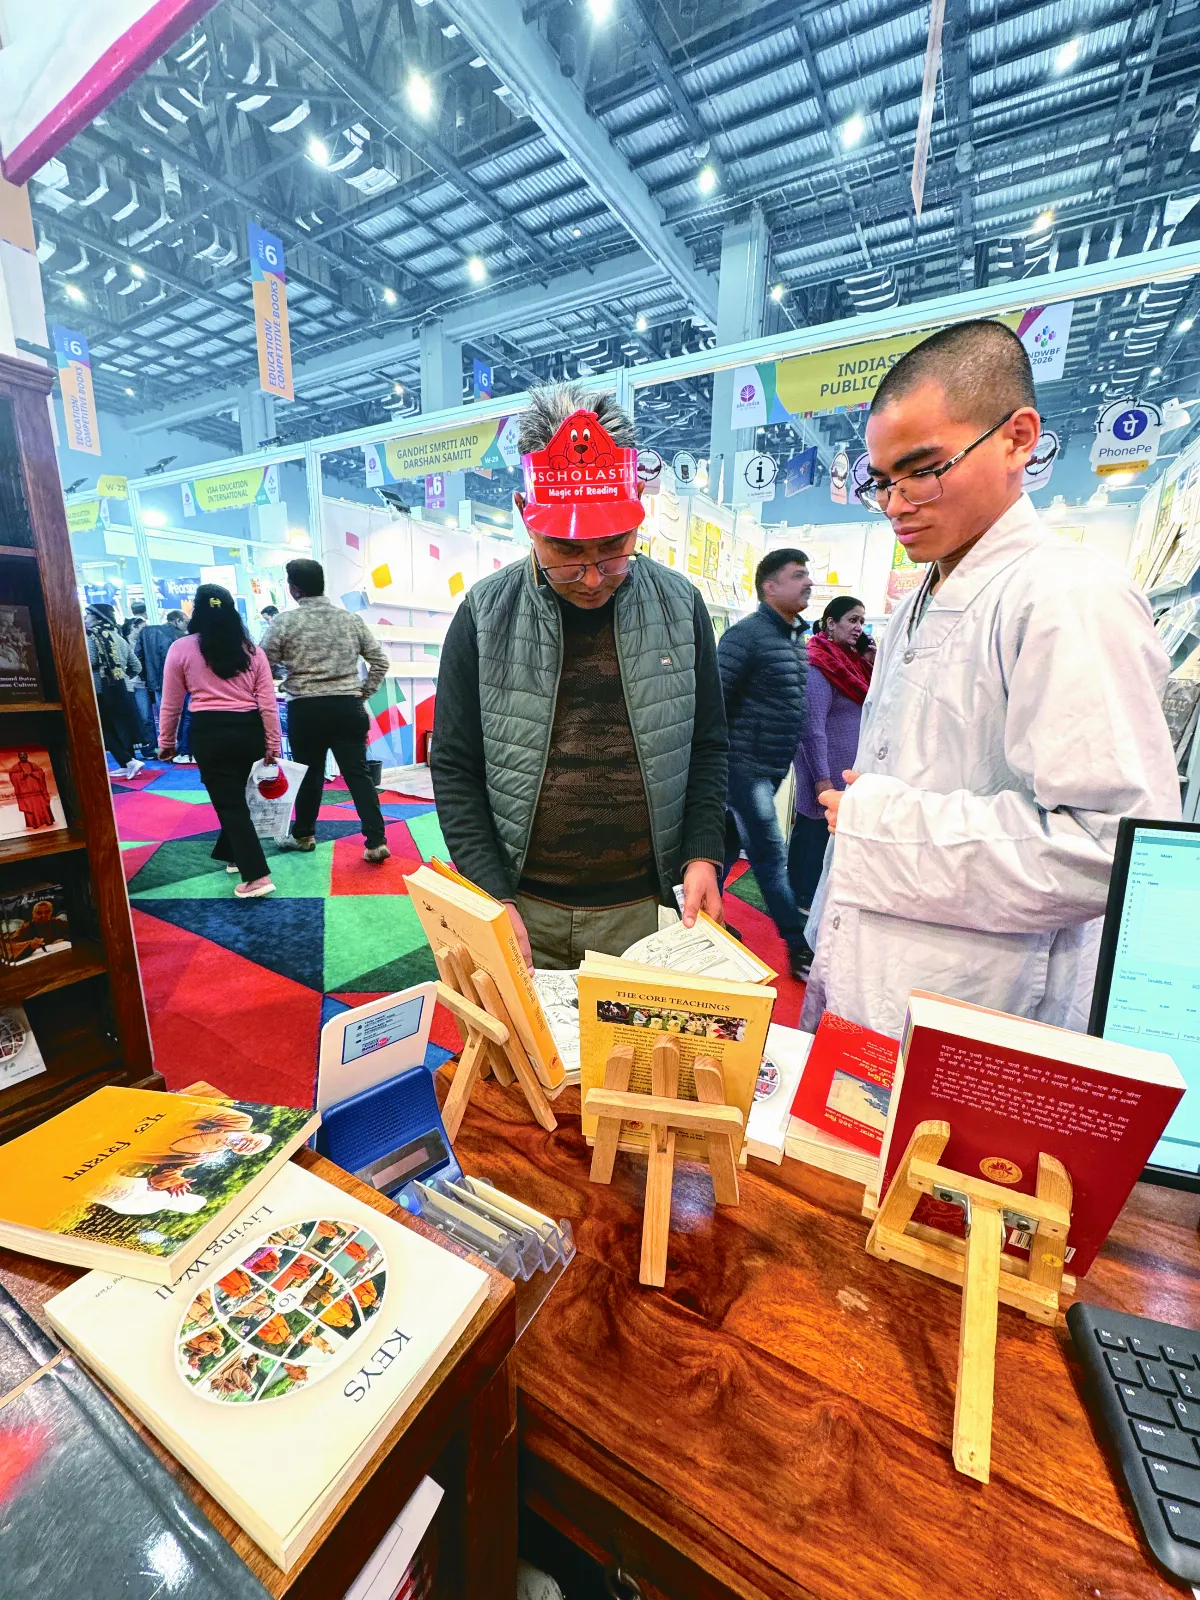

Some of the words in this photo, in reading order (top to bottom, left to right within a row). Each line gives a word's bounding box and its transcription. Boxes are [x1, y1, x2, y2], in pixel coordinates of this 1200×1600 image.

[265, 244, 278, 266] 6
[270, 280, 280, 319] BOOKS
[70, 339, 82, 356] 6
[264, 318, 276, 386] EDUCATION/
[274, 320, 286, 390] COMPETITIVE
[1032, 356, 1052, 365] 2026
[76, 366, 86, 396] BOOKS
[482, 374, 488, 386] 6
[78, 395, 92, 448] COMPETITIVE
[397, 444, 428, 460] GANDHI
[430, 439, 458, 454] SMRITI
[460, 435, 478, 447] AND
[1099, 444, 1152, 458] PhonePe
[404, 456, 440, 469] DARSHAN
[442, 449, 472, 462] SAMITI
[106, 484, 127, 492] W-22
[219, 480, 248, 492] EDUCATION
[549, 487, 571, 499] Magic
[574, 486, 583, 496] of
[587, 486, 618, 498] Reading
[208, 489, 248, 503] INTERNATIONAL
[616, 990, 637, 1000] THE
[639, 993, 667, 1004] CORE
[670, 997, 731, 1012] TEACHINGS
[206, 1204, 274, 1256] Living
[278, 1291, 298, 1309] to
[343, 1327, 412, 1403] KEYS
[1186, 1385, 1192, 1393] 2
[1178, 1403, 1188, 1414] Q
[1139, 1424, 1152, 1433] caps
[1152, 1427, 1165, 1437] lock
[1153, 1463, 1168, 1473] shift
[1170, 1505, 1181, 1514] ctrl
